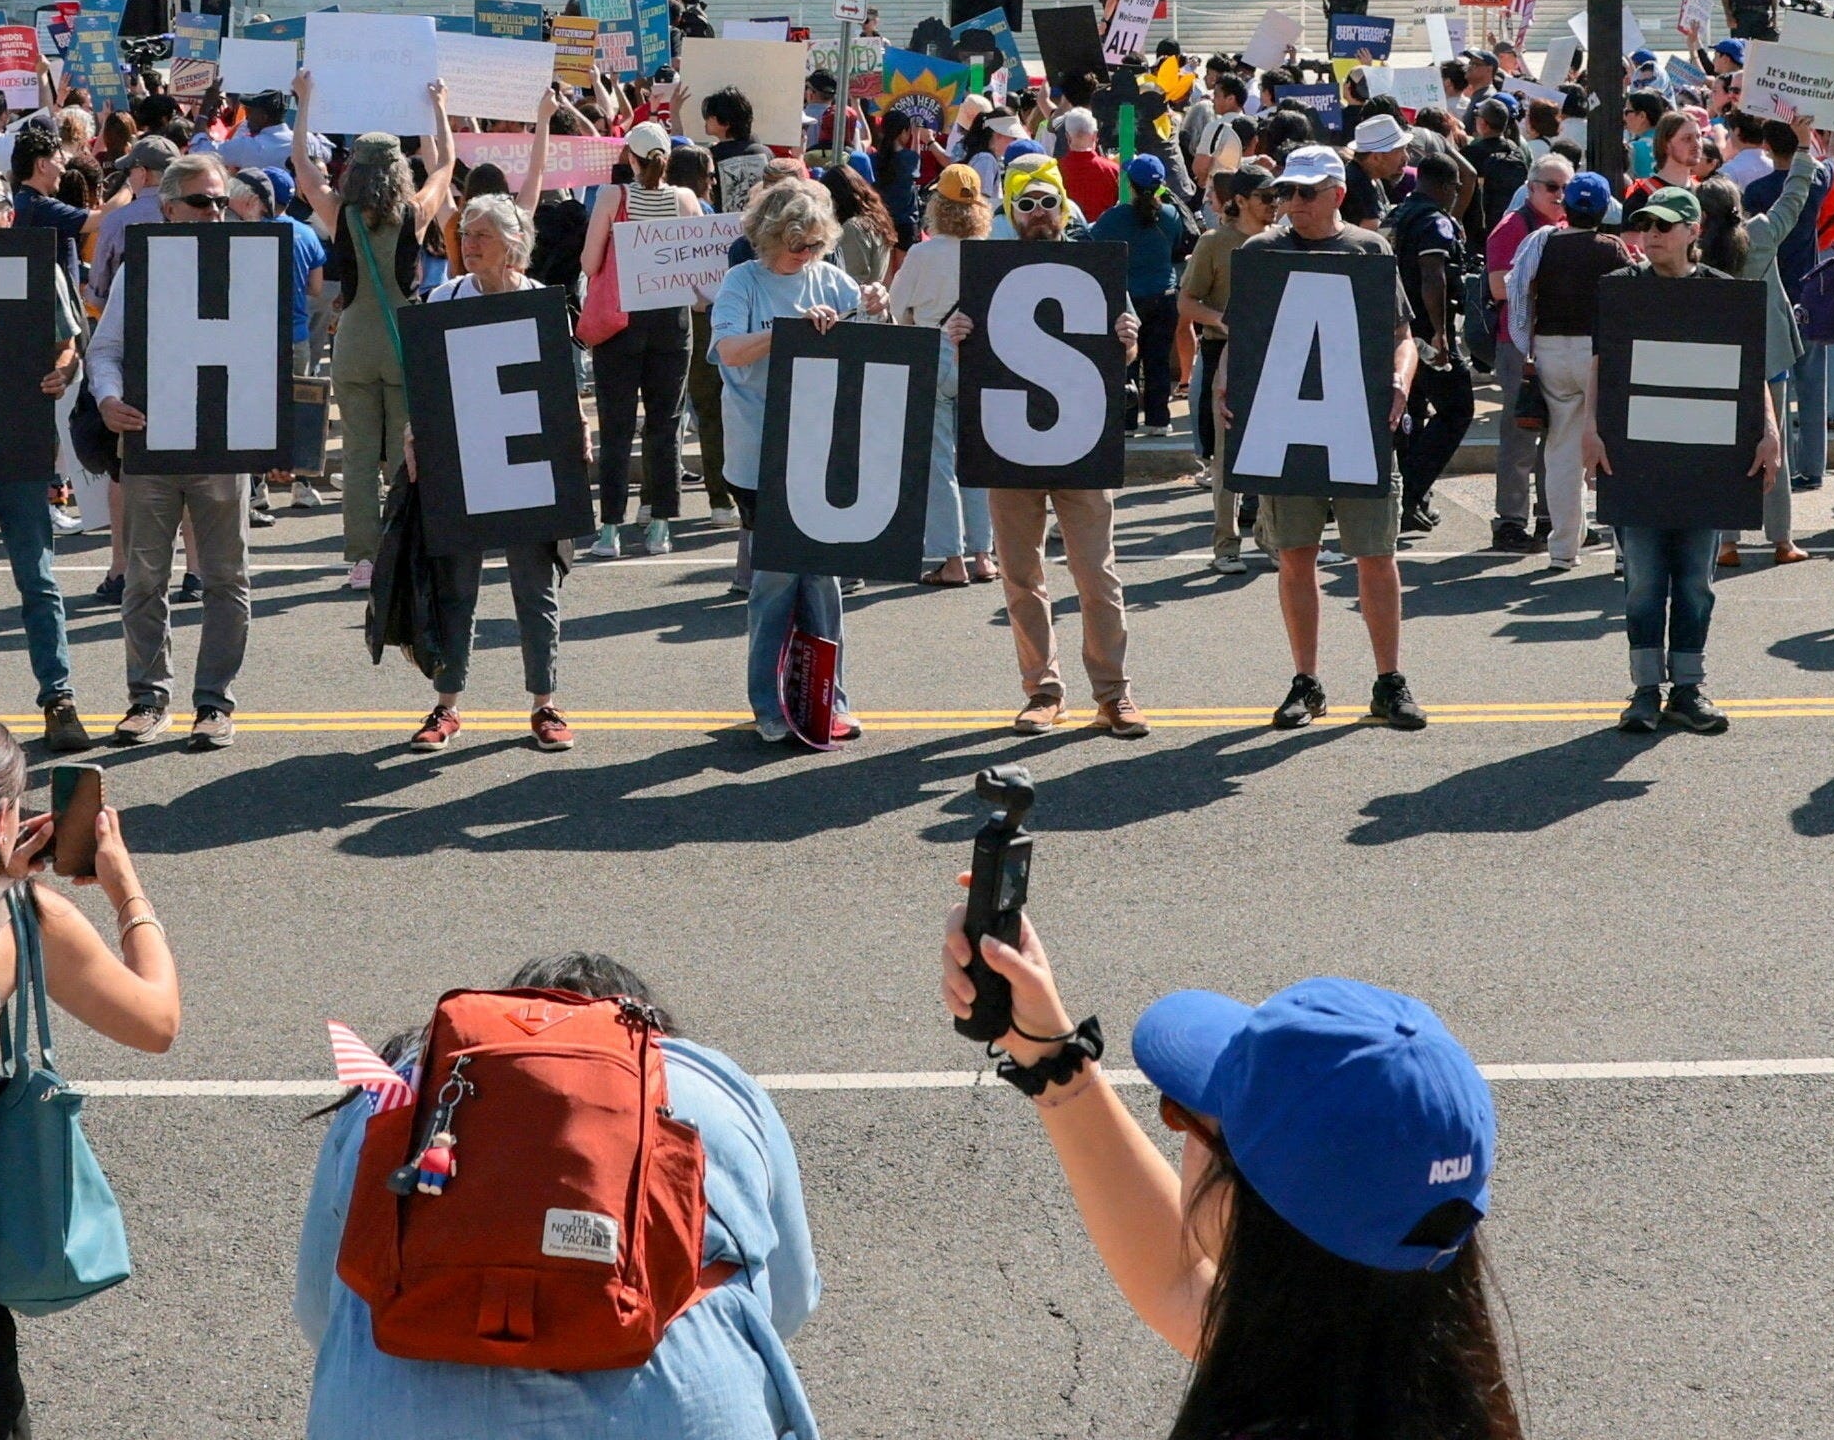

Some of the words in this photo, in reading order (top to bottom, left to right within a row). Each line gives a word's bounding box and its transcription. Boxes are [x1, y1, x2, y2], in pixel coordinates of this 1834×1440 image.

[1105, 30, 1139, 56] ALL
[812, 45, 878, 74] ROTED
[1756, 77, 1776, 89] the
[1766, 66, 1786, 79] It's
[1788, 70, 1834, 90] literally
[917, 94, 941, 113] HERE
[633, 223, 703, 249] NACIDO
[710, 221, 744, 238] AQU
[1428, 1153, 1473, 1185] ACLU
[551, 1222, 592, 1236] NORTH
[571, 1215, 591, 1225] THE
[561, 1233, 592, 1246] FACE
